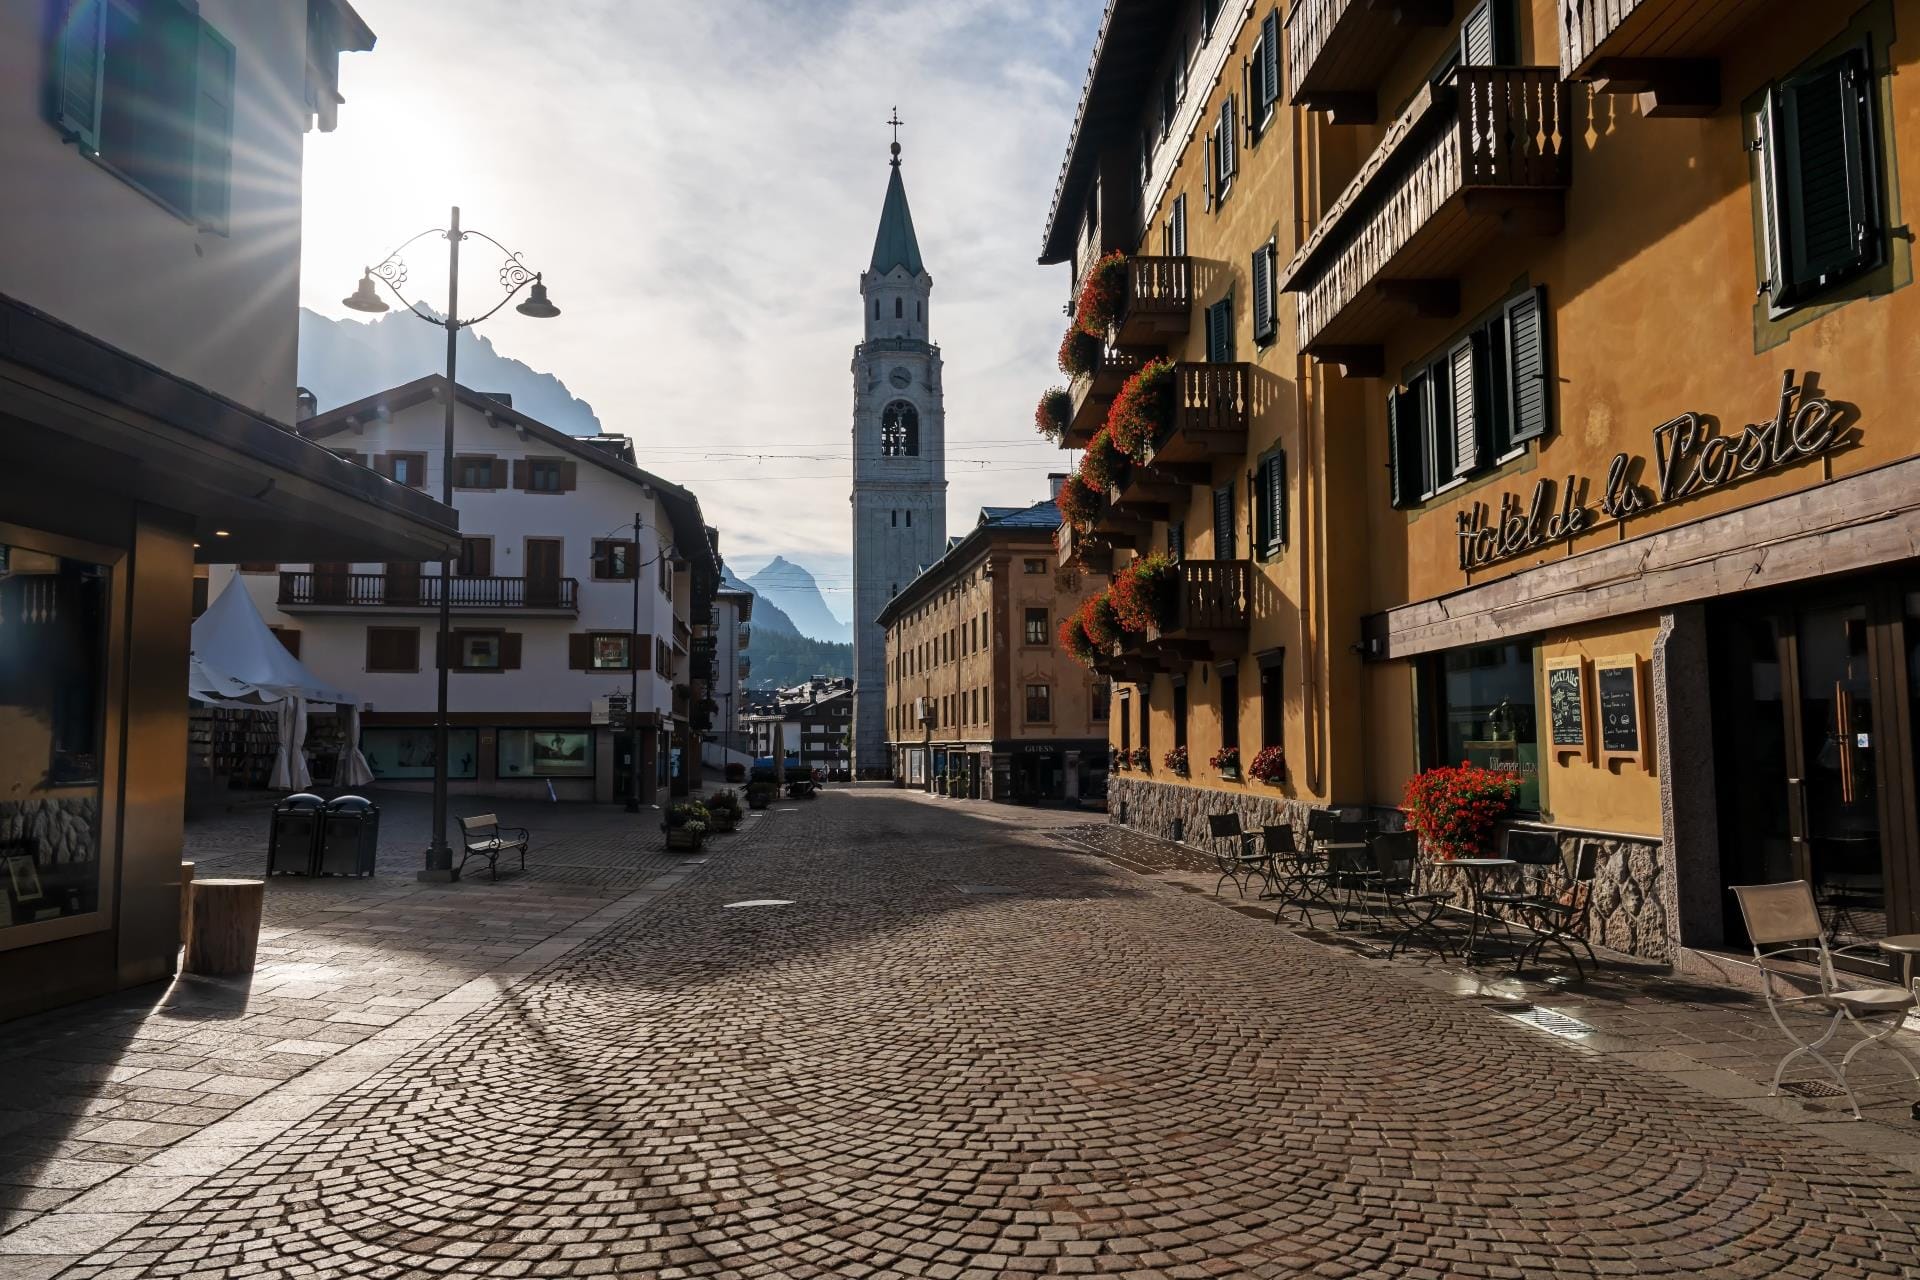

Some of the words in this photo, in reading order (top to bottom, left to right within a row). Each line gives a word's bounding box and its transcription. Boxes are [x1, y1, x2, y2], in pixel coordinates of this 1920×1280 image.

[1456, 477, 1547, 571] Hotel
[1549, 475, 1585, 539] de
[1602, 452, 1643, 518] la
[1653, 368, 1838, 503] Poste
[1024, 743, 1055, 753] GUESS
